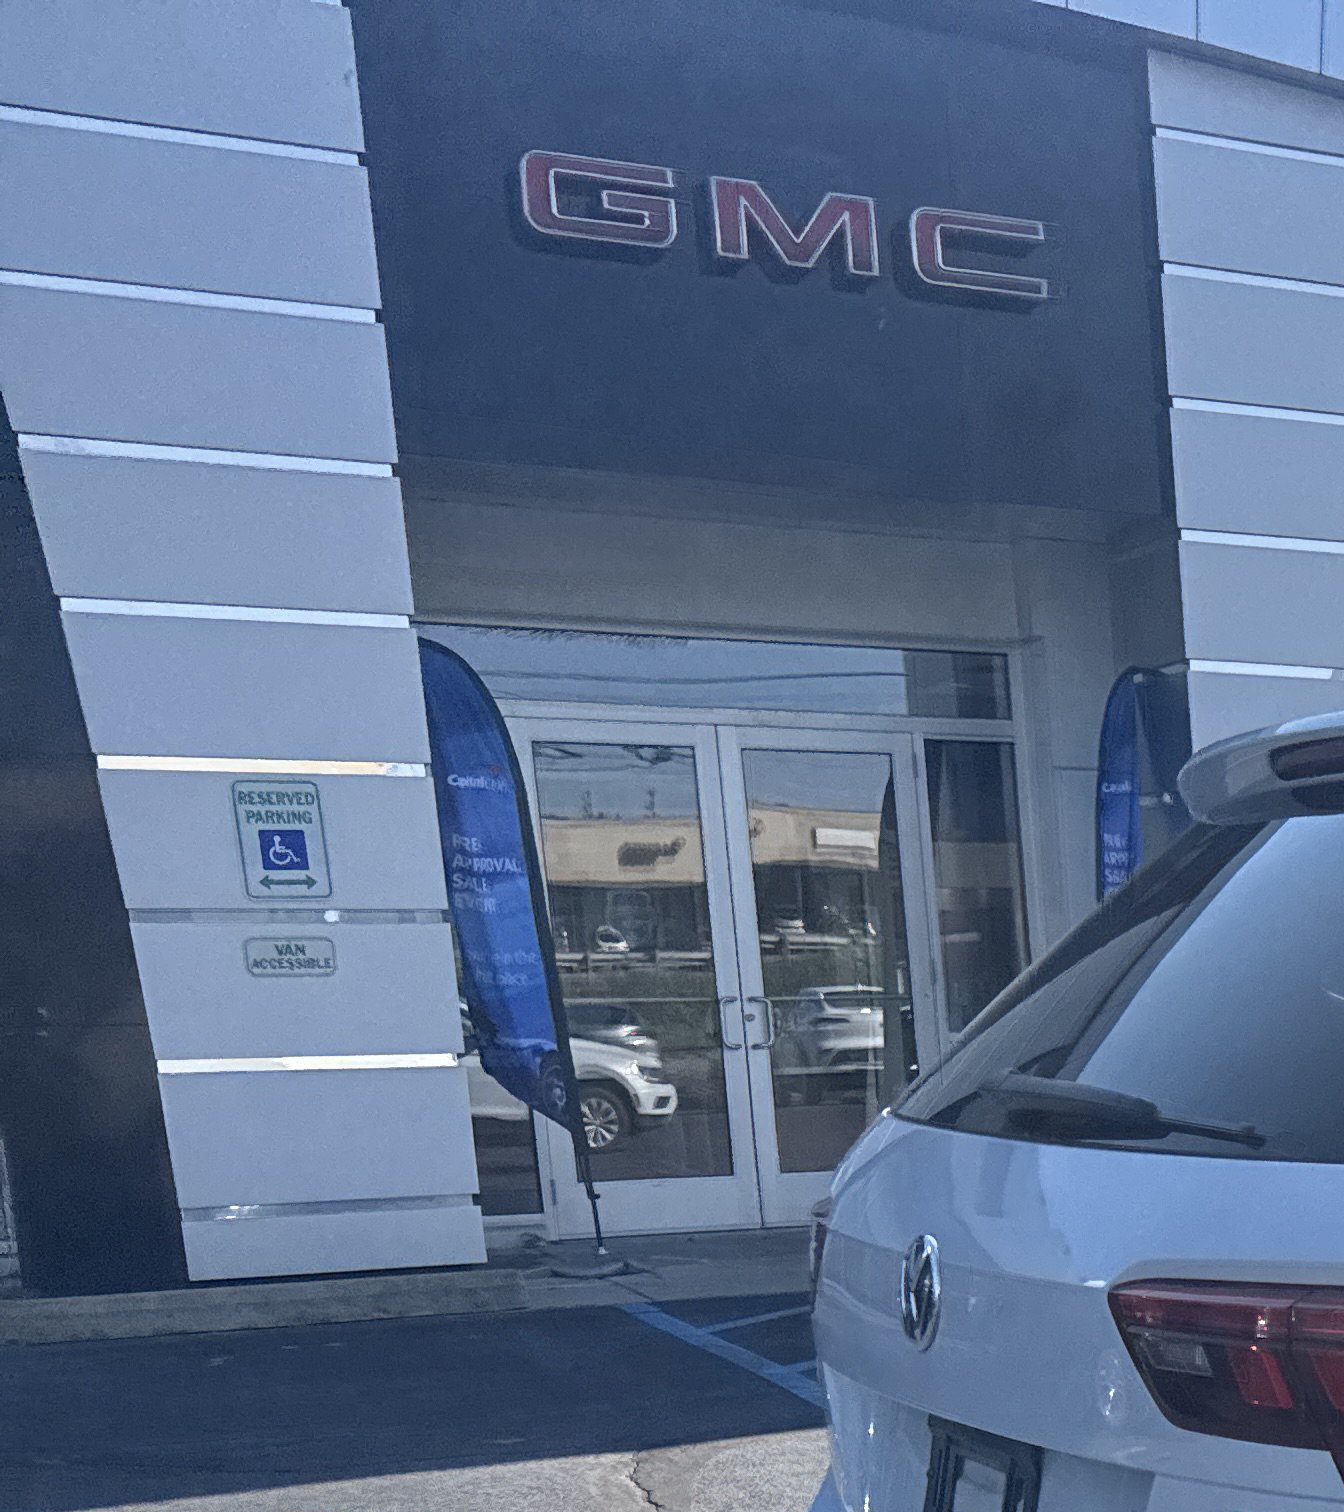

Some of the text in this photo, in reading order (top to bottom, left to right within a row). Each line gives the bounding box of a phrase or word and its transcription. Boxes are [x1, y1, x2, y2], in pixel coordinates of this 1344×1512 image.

[517, 147, 1050, 300] GMC
[237, 789, 315, 806] RESERVED
[245, 809, 314, 825] PARKING
[273, 943, 308, 957] VAN
[250, 957, 334, 972] ACCESSIBLE
